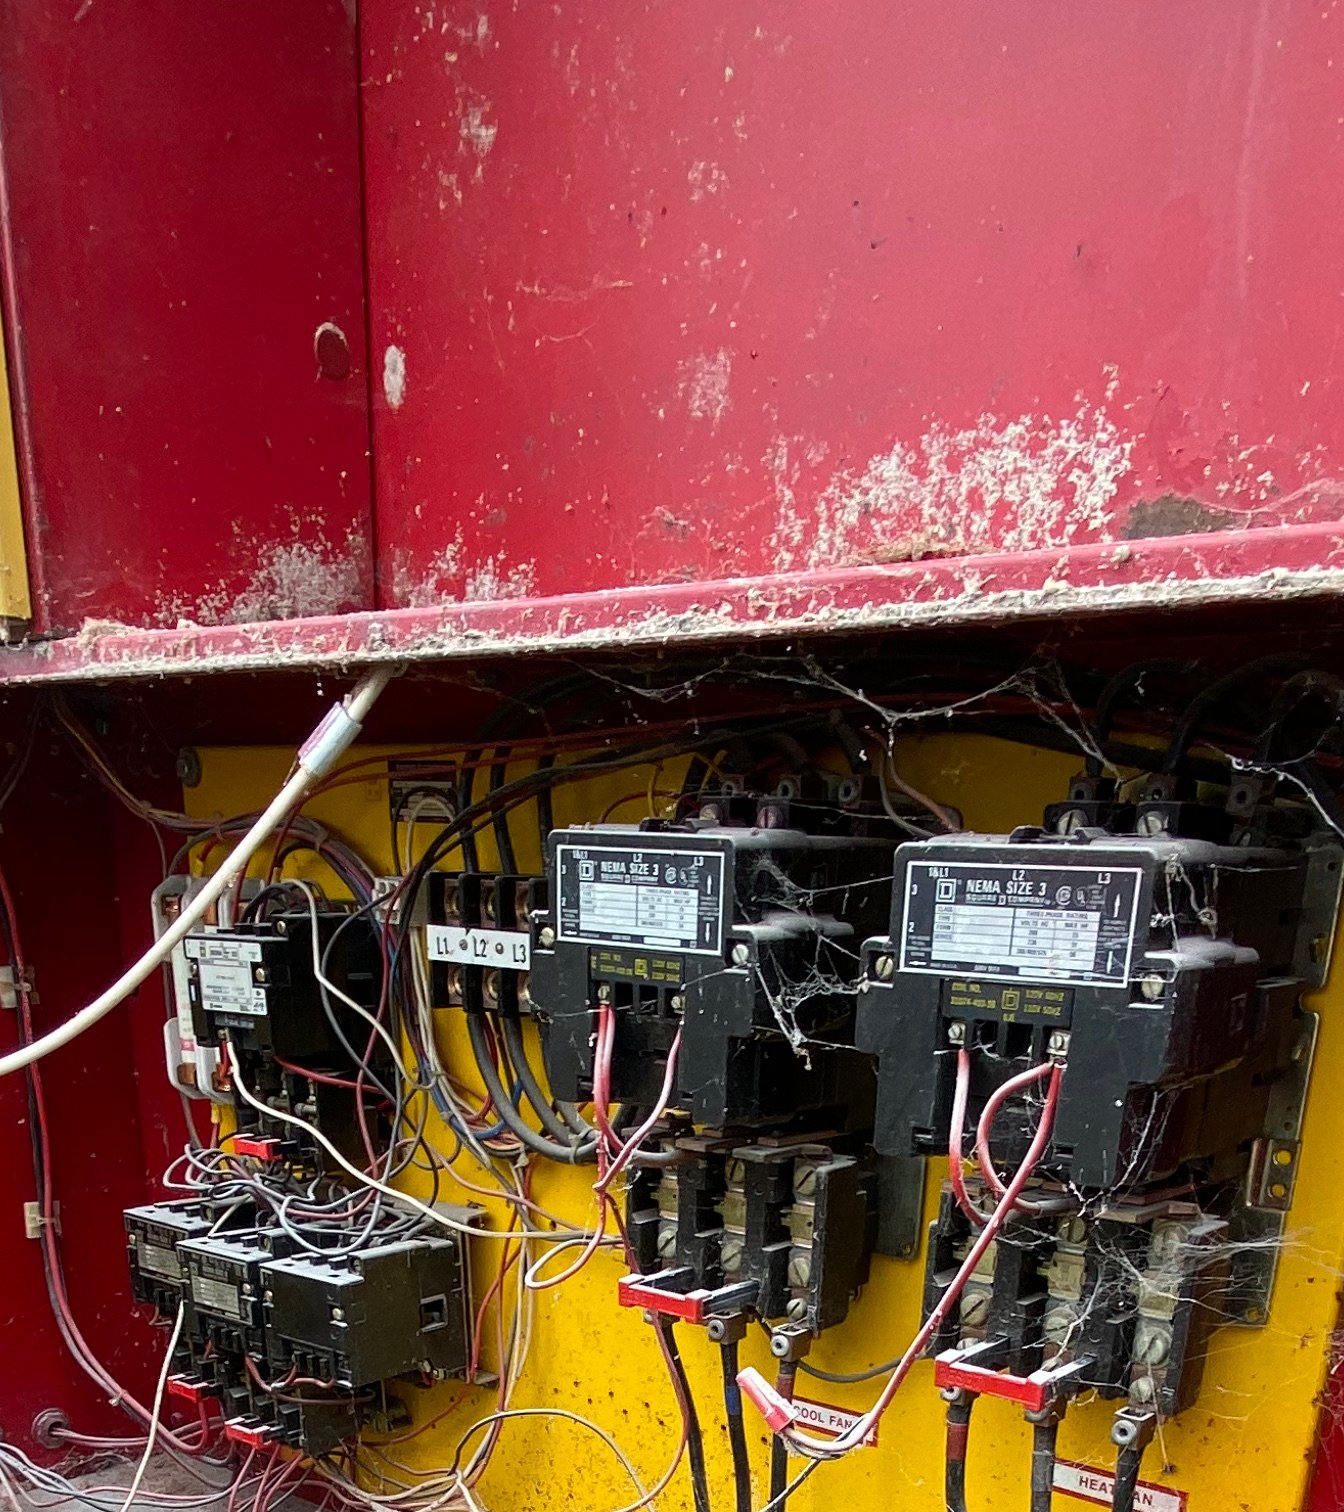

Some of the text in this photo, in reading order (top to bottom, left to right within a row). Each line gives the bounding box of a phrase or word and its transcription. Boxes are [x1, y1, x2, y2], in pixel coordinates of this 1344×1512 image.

[633, 854, 642, 862] L2
[694, 857, 704, 866] L3
[601, 861, 626, 873] NEMA
[629, 863, 649, 875] SIZE
[653, 864, 659, 876] 3
[1012, 870, 1025, 880] L2
[1097, 872, 1111, 884] L3
[966, 880, 1000, 893] NEMA
[1006, 881, 1034, 895] SIZE
[1038, 882, 1047, 896] 3
[436, 935, 526, 963] L1 L2 L3
[829, 1415, 853, 1429] FAN
[1133, 1490, 1153, 1506] AN
